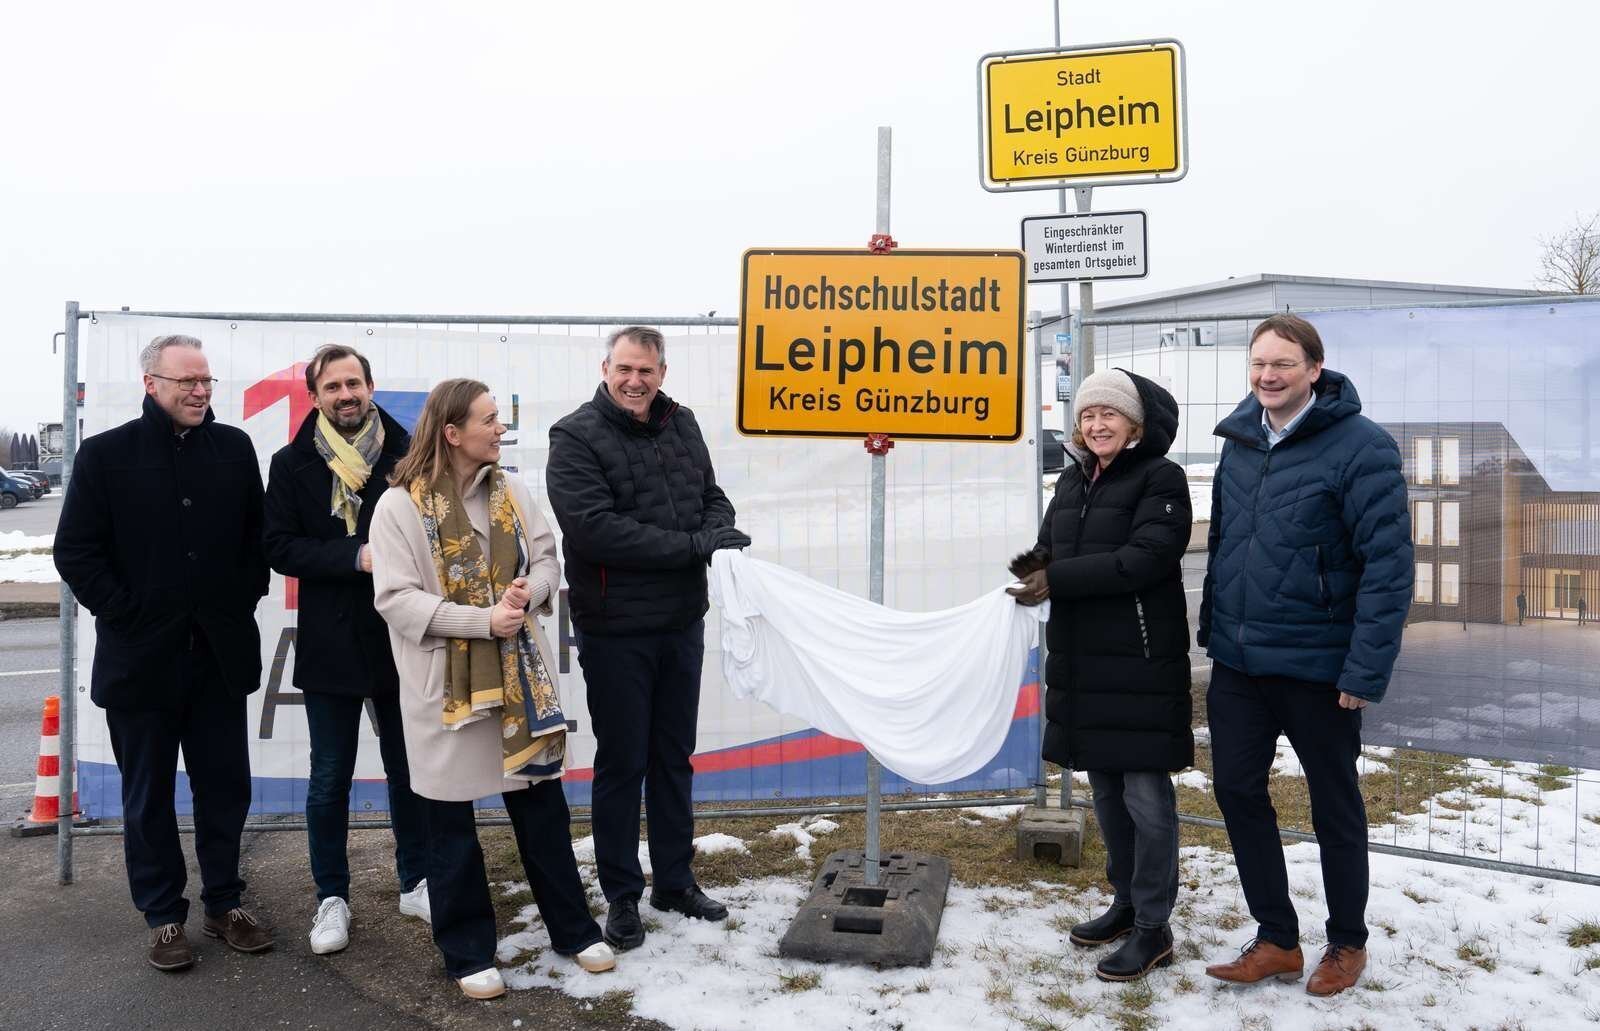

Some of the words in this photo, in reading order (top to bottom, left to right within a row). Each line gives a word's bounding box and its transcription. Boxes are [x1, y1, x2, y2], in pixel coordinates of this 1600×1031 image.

[1057, 68, 1101, 86] Stadt
[1004, 95, 1160, 138] Leipheim
[1013, 149, 1058, 166] Kreis
[1065, 144, 1150, 163] Günzburg
[1044, 224, 1124, 240] Eingeschränkter
[1045, 241, 1107, 254] Winterdienst
[1112, 240, 1125, 251] im
[1033, 257, 1080, 274] gesamten
[1085, 254, 1137, 270] Ortsgebiet
[764, 275, 1000, 312] Hochschulstadt
[755, 325, 1007, 384] Leipheim
[770, 386, 841, 411] Kreis
[856, 388, 989, 421] Günzburg
